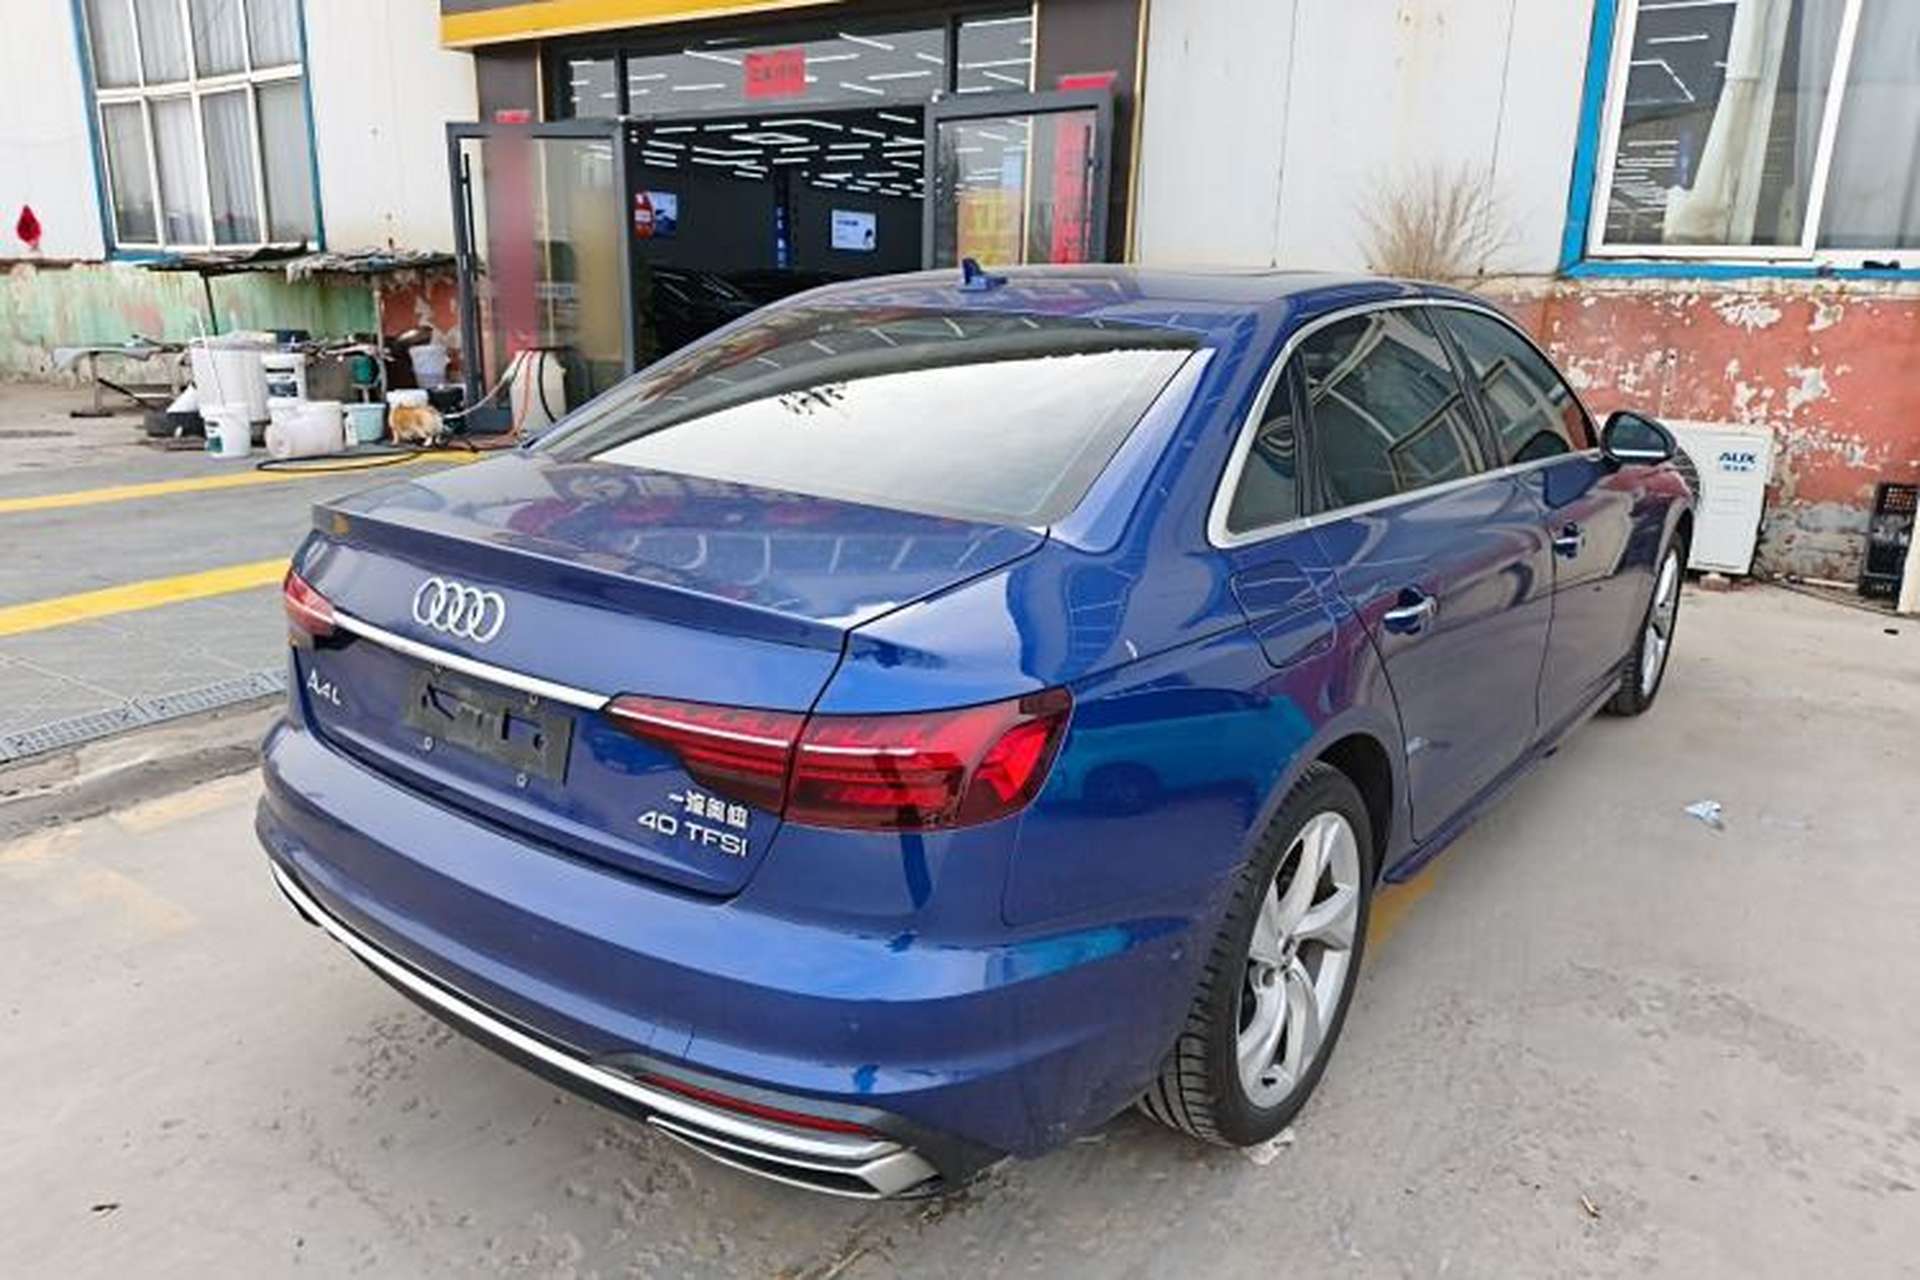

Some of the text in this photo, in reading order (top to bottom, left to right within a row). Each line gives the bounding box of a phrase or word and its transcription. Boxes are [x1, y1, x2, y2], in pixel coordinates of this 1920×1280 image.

[1719, 451, 1757, 465] AUX
[303, 666, 341, 706] A4L
[637, 810, 748, 857] 40 TFSI
